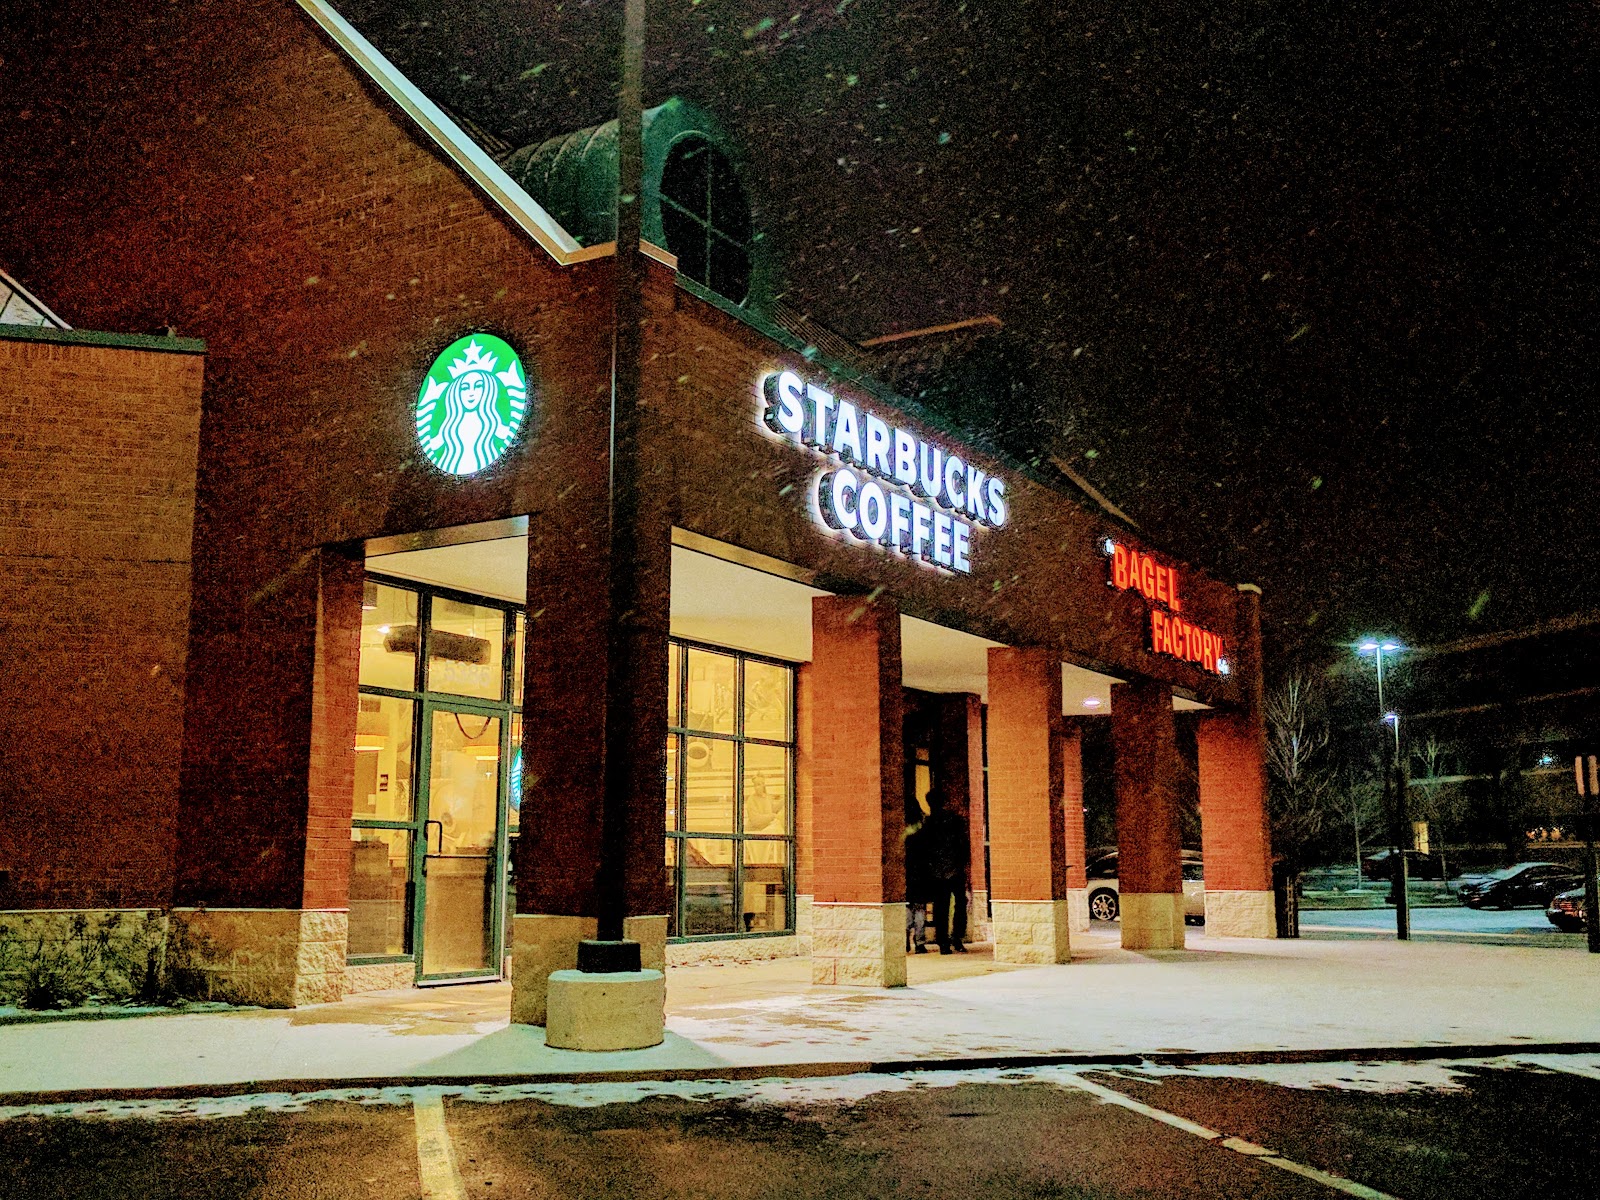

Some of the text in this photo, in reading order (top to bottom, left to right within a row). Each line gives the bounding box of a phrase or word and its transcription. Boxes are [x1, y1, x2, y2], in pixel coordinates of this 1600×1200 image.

[766, 370, 1007, 527] STARBUCKS
[820, 467, 971, 574] COFFEE
[1114, 543, 1181, 612] BAGEL
[1151, 609, 1223, 675] FACTORY
